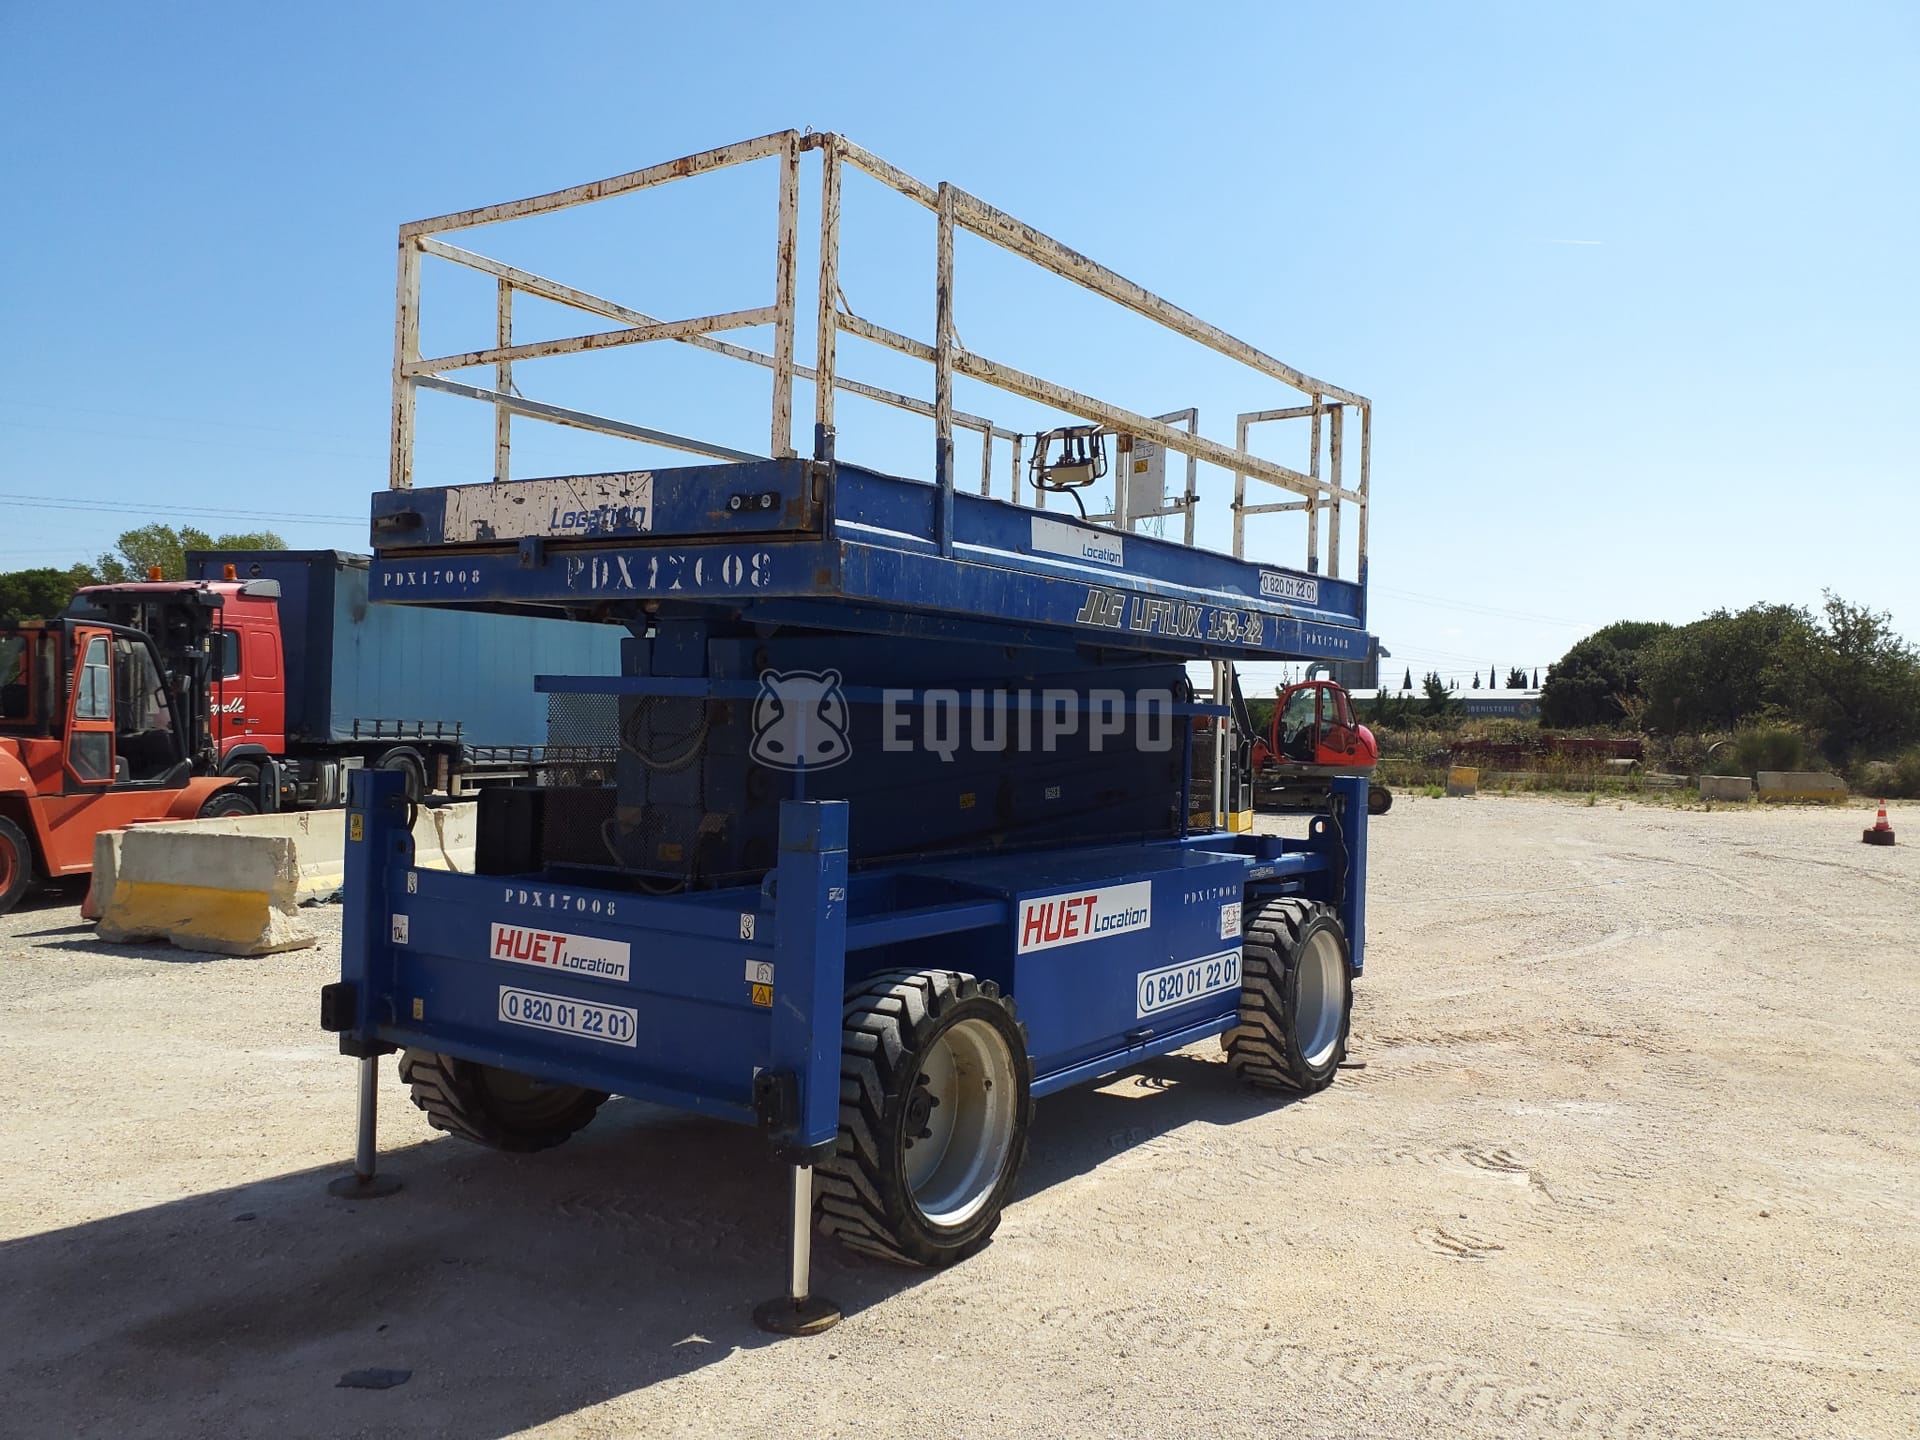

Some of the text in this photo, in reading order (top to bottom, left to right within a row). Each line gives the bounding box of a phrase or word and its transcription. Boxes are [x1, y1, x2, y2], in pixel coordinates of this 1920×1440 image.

[1082, 543, 1121, 564] Location
[383, 569, 480, 586] PDX17008
[1263, 576, 1315, 599] 0 820 01 22 01
[1076, 589, 1263, 645] JLG LIFTLUX 153-22
[210, 696, 245, 716] apelle
[505, 888, 616, 916] PDX17008
[1184, 885, 1237, 905] PDX17008
[1023, 896, 1147, 946] HUET Location
[495, 928, 625, 976] HUET Location
[1146, 956, 1237, 1006] 0 820 01 22 01
[509, 995, 628, 1037] 0 820 01 22 01
